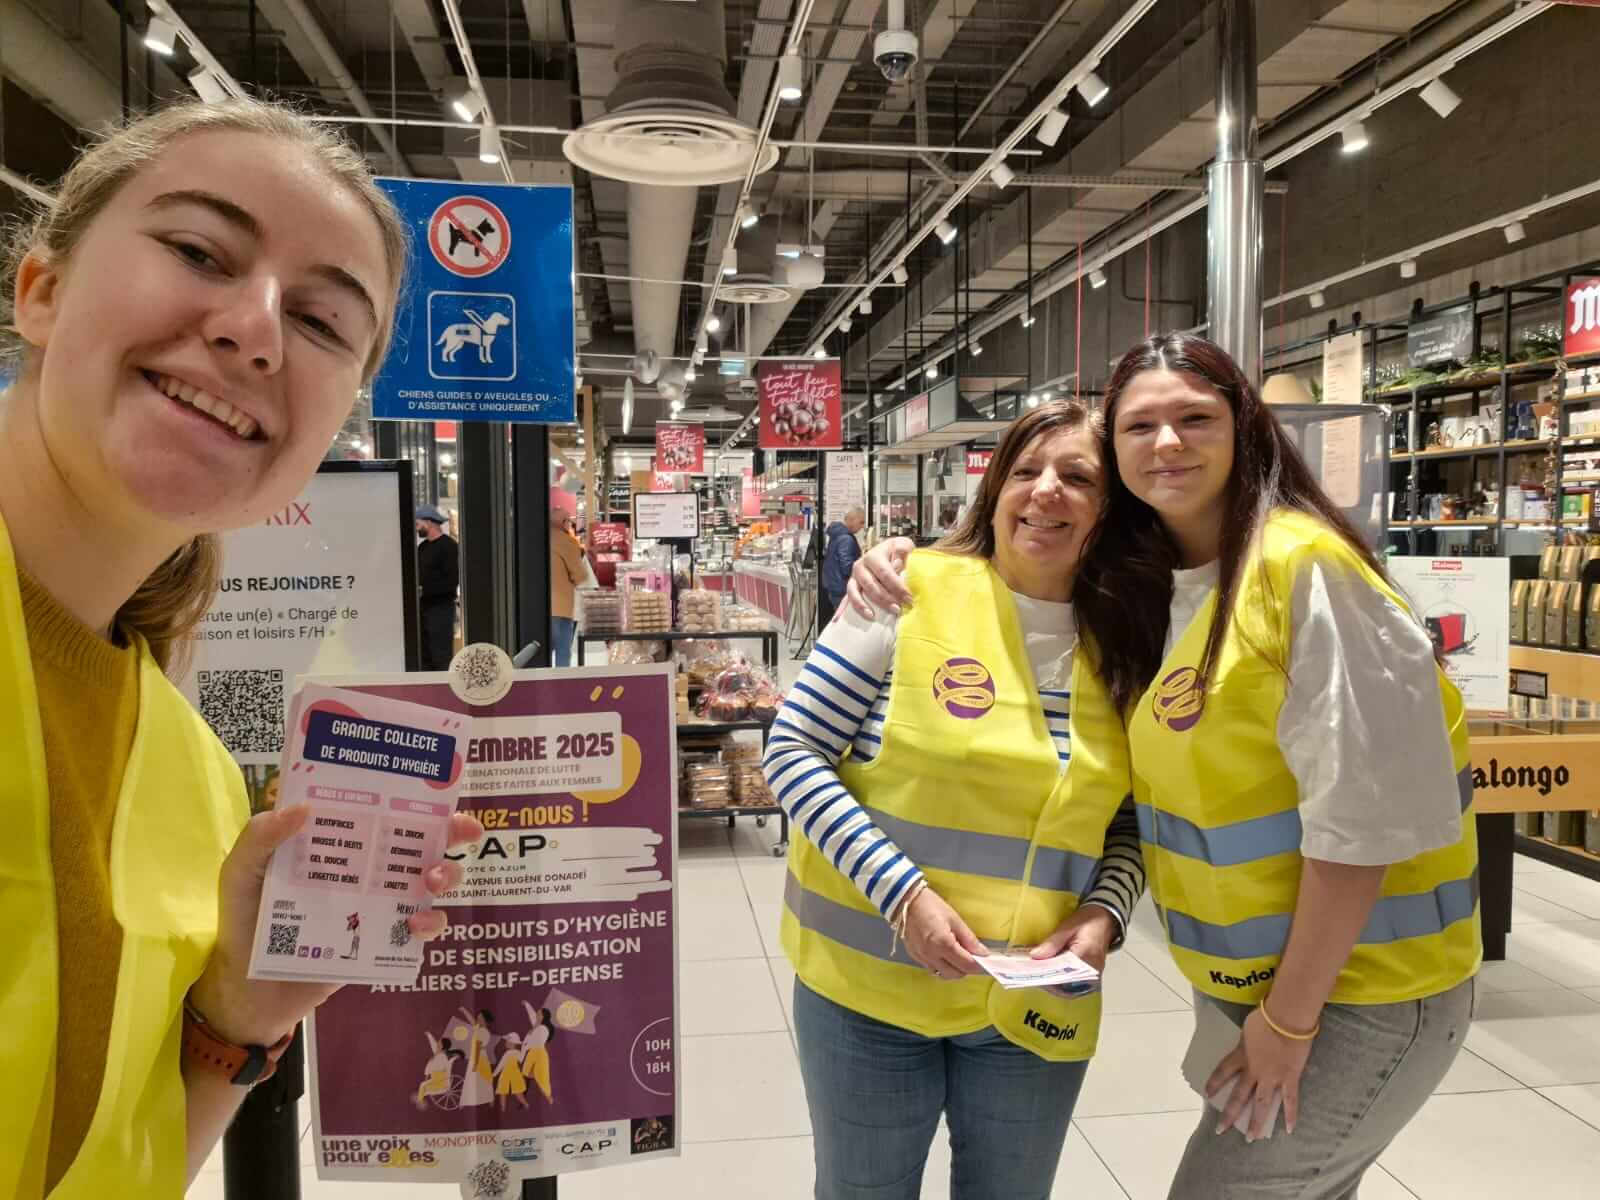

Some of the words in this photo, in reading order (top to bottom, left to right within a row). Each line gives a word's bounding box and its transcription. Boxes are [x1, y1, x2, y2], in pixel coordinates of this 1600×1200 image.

[398, 390, 434, 400] CHIENS
[436, 391, 472, 400] GUIDES
[474, 392, 533, 401] D'AVEUGLES
[536, 393, 549, 401] OU
[408, 401, 476, 411] D'ASSISTANCE
[480, 403, 540, 412] UNIQUEMENT
[968, 453, 990, 468] Ma
[218, 578, 243, 592] US
[247, 576, 342, 591] REJOINDRE
[346, 575, 355, 589] ?
[237, 608, 273, 623] un(e)
[288, 607, 337, 624] Chargé
[341, 608, 359, 620] de
[193, 627, 232, 640] aison
[238, 627, 249, 640] et
[254, 626, 295, 639] loisirs
[300, 626, 325, 640] F/H
[332, 720, 381, 741] GRANDE
[384, 729, 439, 752] COLLECTE
[466, 736, 547, 763] EMBRE
[556, 732, 615, 758] 2025
[321, 745, 336, 759] DE
[338, 748, 389, 767] PRODUITS
[392, 756, 440, 776] D'HYGIÈNE
[465, 766, 536, 778] ERNATIONALE
[537, 766, 549, 776] DE
[551, 764, 580, 775] LUTTE
[1473, 758, 1569, 796] alongo
[465, 780, 500, 792] LENCES
[502, 778, 537, 790] FAITES
[539, 777, 560, 788] AUX
[562, 775, 602, 786] FEMMES
[310, 854, 321, 864] GEL
[324, 856, 348, 866] DOUCHE
[489, 864, 526, 872] D'AZUR
[505, 873, 542, 885] EUGÈNE
[461, 884, 572, 898] SAINT-LAURENT-DU-VAR
[442, 920, 548, 942] PRODUITS
[553, 909, 667, 936] D'HYGIÈNE
[430, 949, 457, 967] DE
[462, 937, 641, 965] SENSIBILISATION
[472, 963, 623, 989] SELF-DEFENSE
[1209, 966, 1275, 990] Kapriol
[1023, 1009, 1077, 1041] Kapriol
[645, 1038, 671, 1052] 10H
[646, 1061, 671, 1074] 18H
[322, 1139, 361, 1151] une
[367, 1136, 410, 1151] voix
[424, 1134, 496, 1149] MONOPRIX
[323, 1150, 371, 1167] pour
